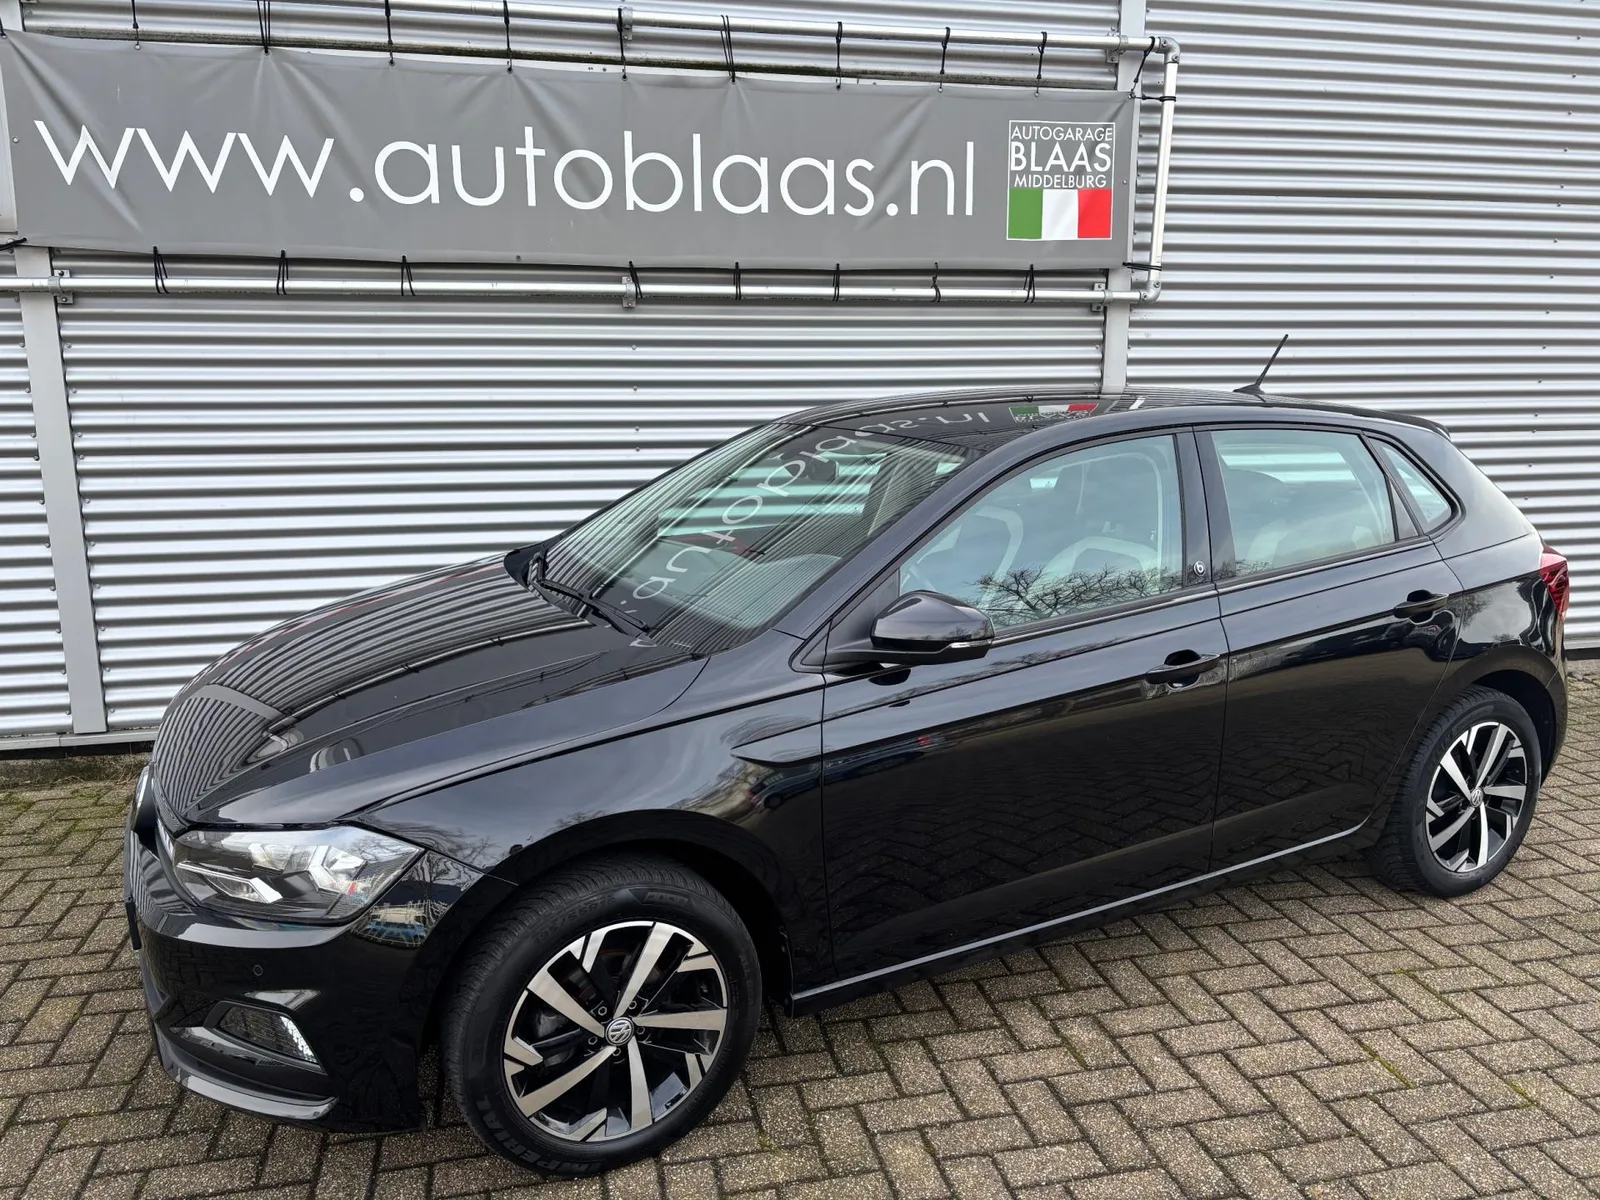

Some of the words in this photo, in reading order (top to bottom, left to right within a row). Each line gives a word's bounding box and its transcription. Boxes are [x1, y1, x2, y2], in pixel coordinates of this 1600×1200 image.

[1011, 125, 1113, 142] AUTOGARAGE
[34, 120, 974, 217] www.autoblaas.nl
[1010, 141, 1112, 173] BLAAS
[1014, 174, 1107, 188] MIDDELBURG
[472, 1094, 602, 1174] IMPERIAL
